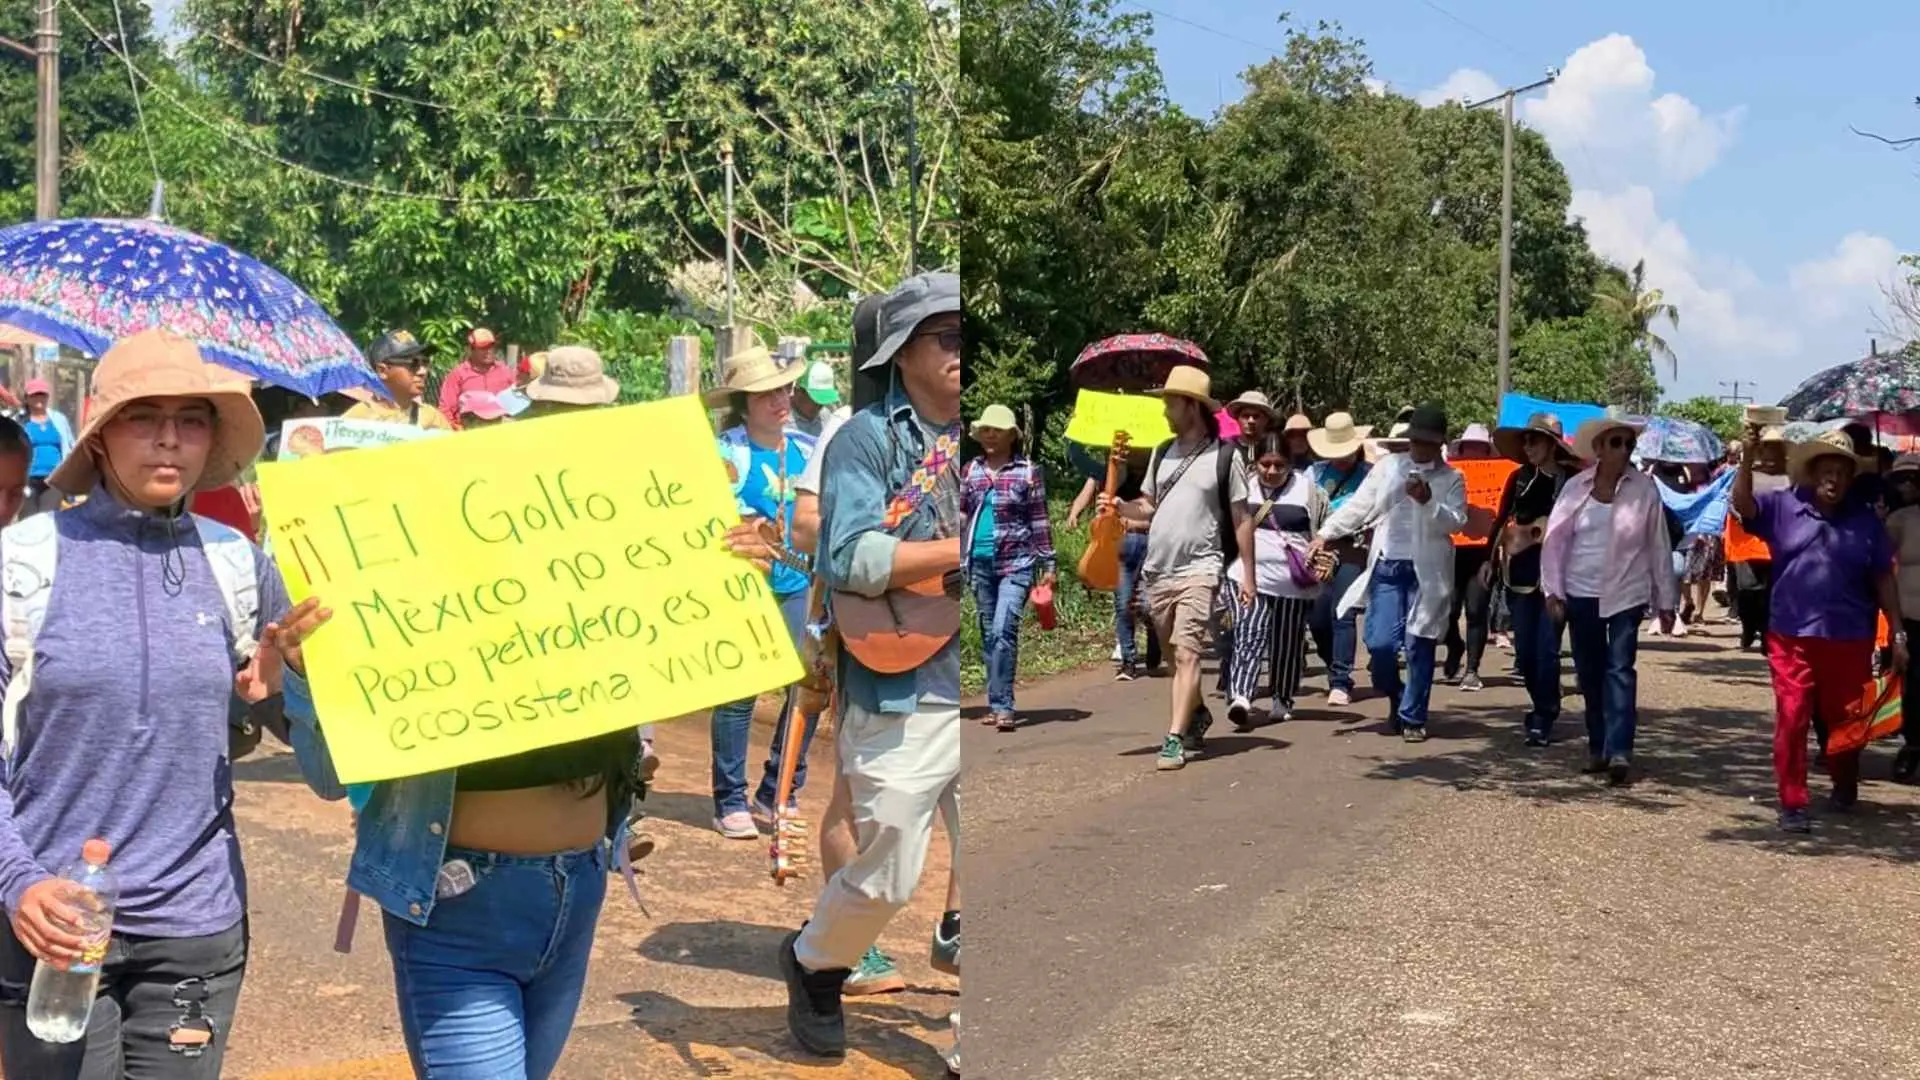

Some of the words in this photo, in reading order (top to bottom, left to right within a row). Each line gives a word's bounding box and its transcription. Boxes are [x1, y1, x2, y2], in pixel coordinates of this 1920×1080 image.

[461, 469, 616, 544] Golfo
[644, 469, 693, 508] de
[547, 552, 605, 591] no
[625, 537, 672, 569] es
[683, 517, 728, 550] un
[473, 602, 658, 683] petrolero,
[663, 590, 710, 625] es
[724, 572, 762, 602] un
[389, 673, 634, 751] ecosistema
